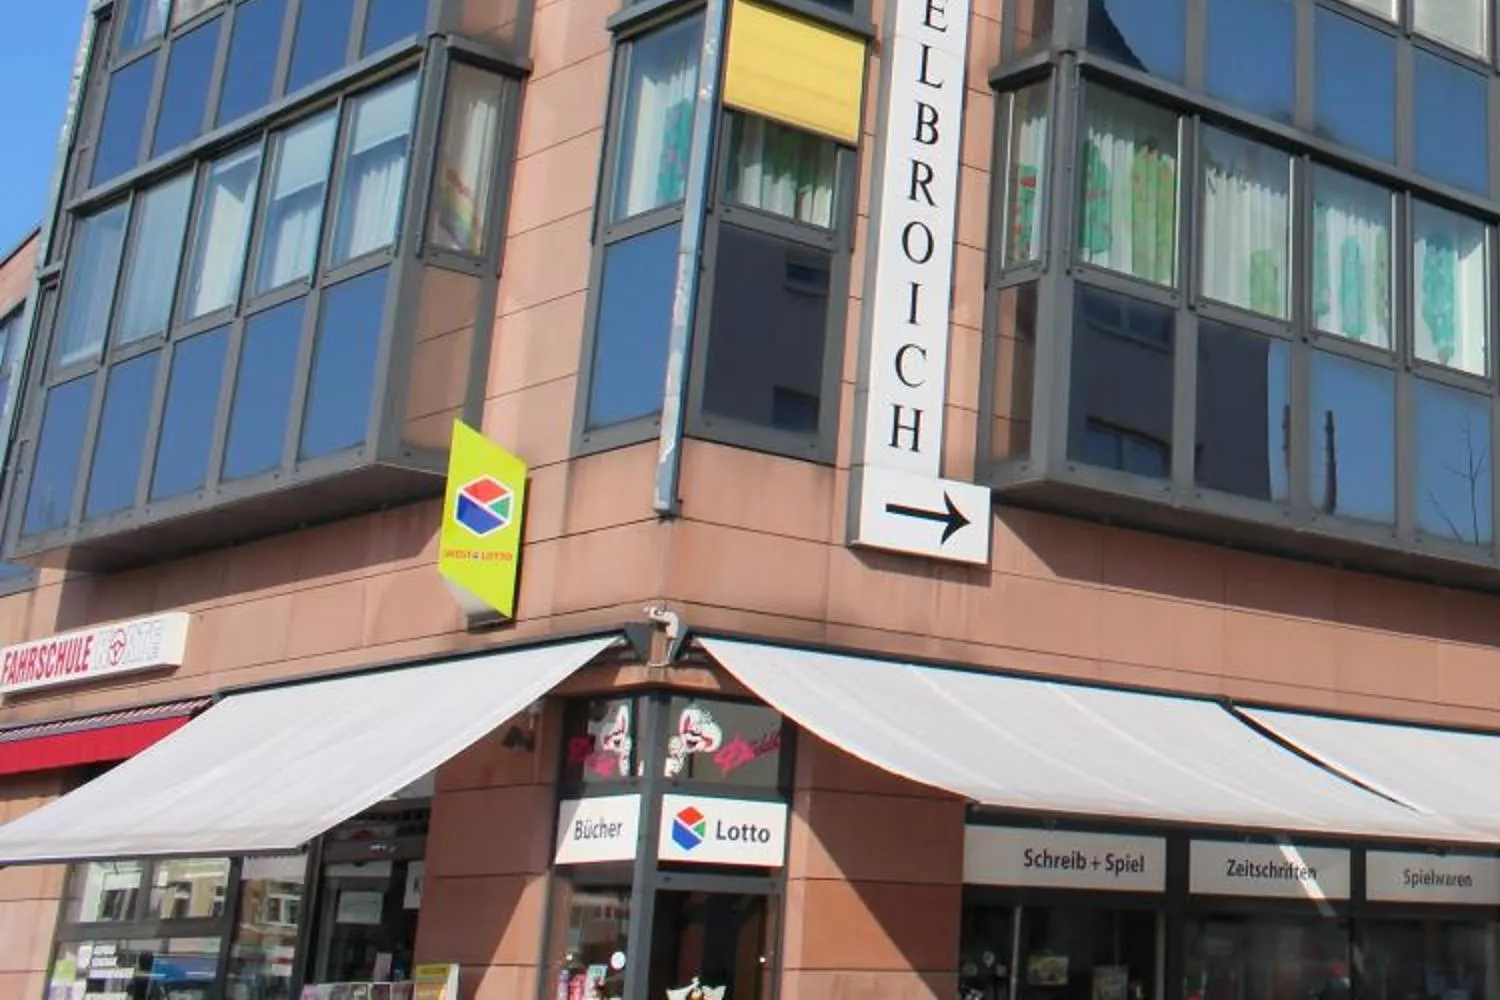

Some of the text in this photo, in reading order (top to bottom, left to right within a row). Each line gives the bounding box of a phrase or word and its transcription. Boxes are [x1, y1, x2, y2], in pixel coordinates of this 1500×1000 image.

[2, 635, 94, 685] FAHRSCHULE
[573, 818, 623, 841] Bücher
[715, 820, 771, 843] Lotto
[1023, 847, 1087, 871] Schreib
[1105, 852, 1145, 878] Spiel
[1226, 858, 1318, 881] Zeitschriften
[1402, 867, 1474, 889] Spielwaren
